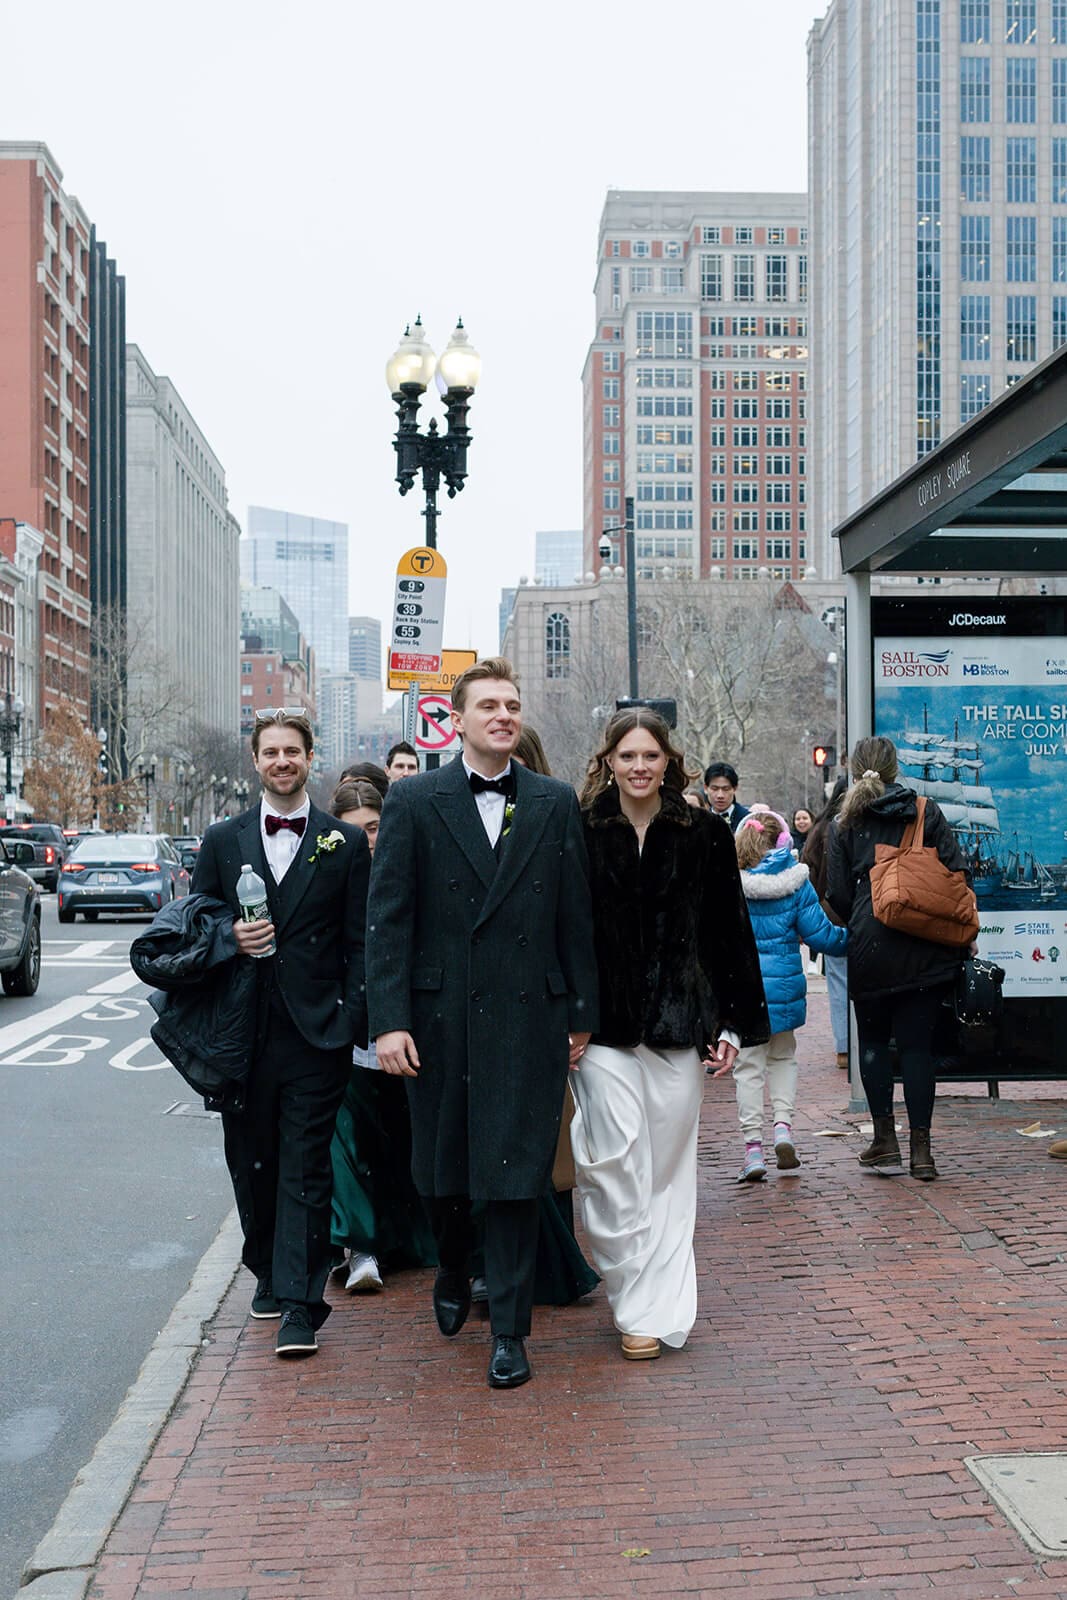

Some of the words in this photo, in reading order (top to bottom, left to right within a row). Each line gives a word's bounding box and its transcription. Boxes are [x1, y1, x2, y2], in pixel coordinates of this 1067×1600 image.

[918, 472, 942, 506] COPLEY
[947, 451, 971, 489] SQUARE
[415, 556, 430, 569] T
[408, 581, 415, 592] 9
[402, 604, 417, 615] 39
[948, 613, 1006, 626] JCDecaux
[401, 626, 415, 637] 55
[881, 651, 920, 664] SAIL
[882, 664, 949, 677] BOSTON
[962, 705, 999, 720] THE
[1003, 705, 1046, 720] TALL
[983, 723, 1016, 739] ARE
[1025, 743, 1058, 756] JULY
[978, 925, 1005, 935] idelity
